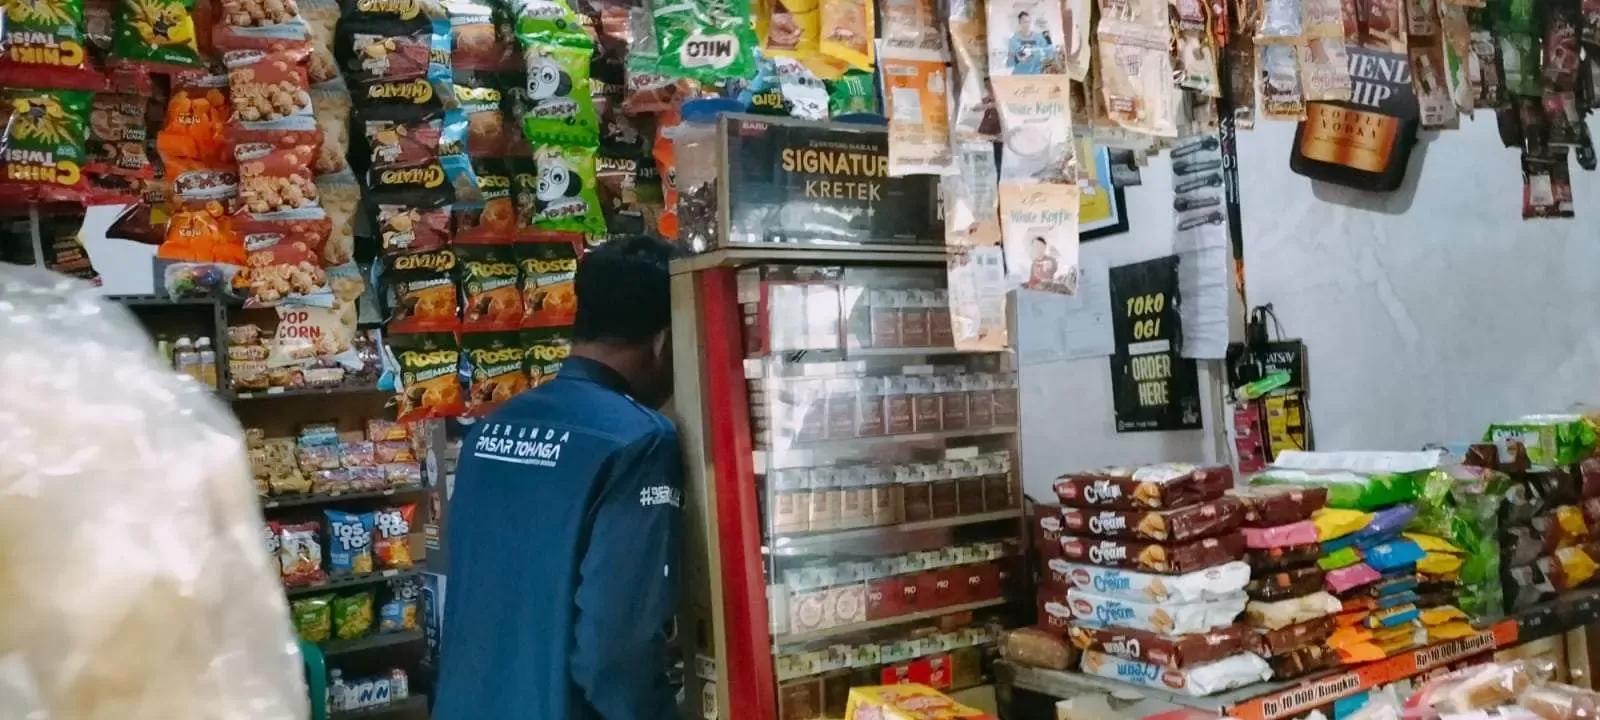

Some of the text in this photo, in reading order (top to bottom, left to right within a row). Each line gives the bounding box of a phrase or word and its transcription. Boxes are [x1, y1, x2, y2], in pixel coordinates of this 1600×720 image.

[11, 41, 84, 66] CHIKI
[687, 40, 732, 57] MILO
[369, 78, 433, 104] CHITATO
[752, 92, 783, 109] Taro
[8, 160, 81, 185] CHIKI
[381, 164, 445, 188] CHITATO
[806, 180, 881, 201] KRETEK
[395, 250, 456, 272] CHITATO
[1127, 293, 1164, 316] TOKO
[1134, 320, 1160, 339] OGI
[1132, 355, 1171, 381] ORDER
[1138, 381, 1169, 406] HERE
[476, 436, 561, 460] PASAR TOHAGA
[332, 522, 364, 537] TOS
[379, 521, 409, 538] TOS
[1089, 515, 1126, 534] Cream
[340, 532, 371, 550] TOS
[1089, 545, 1126, 564] Cream
